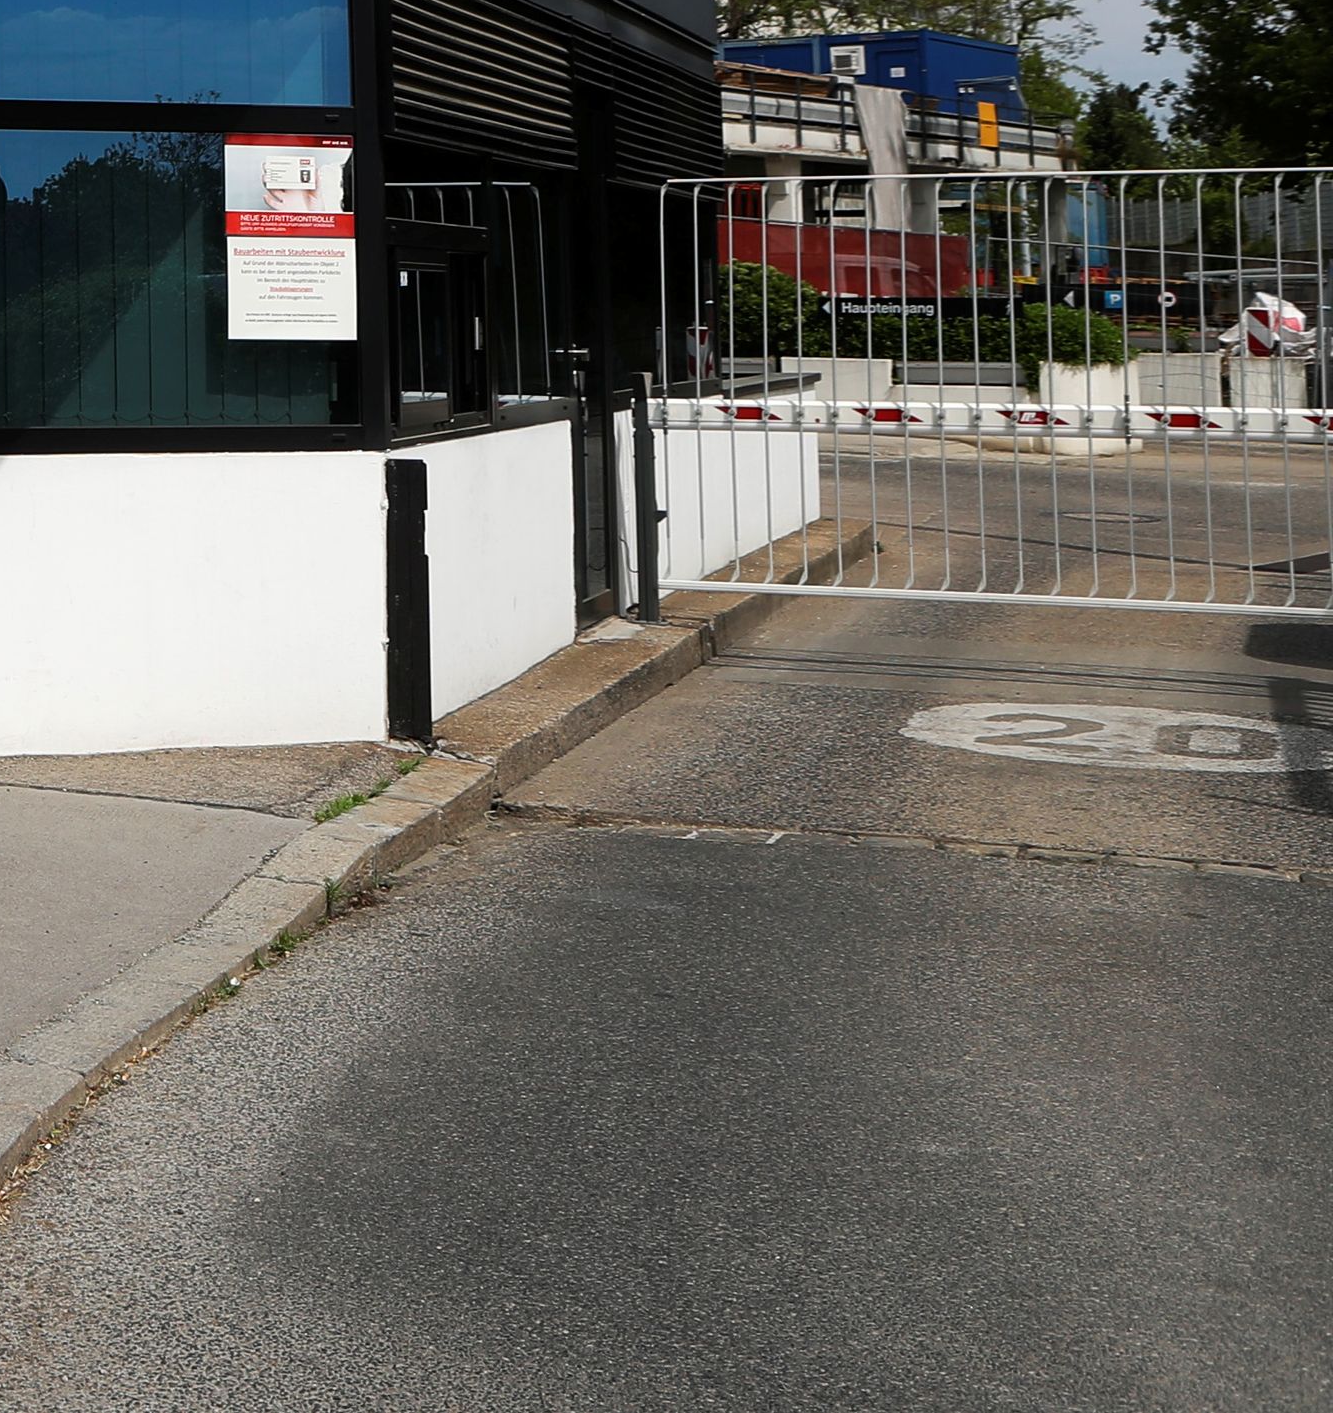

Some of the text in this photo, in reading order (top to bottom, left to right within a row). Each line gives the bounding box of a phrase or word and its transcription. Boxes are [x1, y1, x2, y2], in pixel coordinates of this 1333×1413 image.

[240, 214, 335, 223] NEUE ZUTRITTSKONTROLLE
[234, 248, 274, 257] Bauarbeiten
[288, 249, 346, 258] Staubentwicklung
[1108, 293, 1121, 305] P
[841, 302, 934, 316] Haupteingang
[974, 712, 1279, 761] 20
